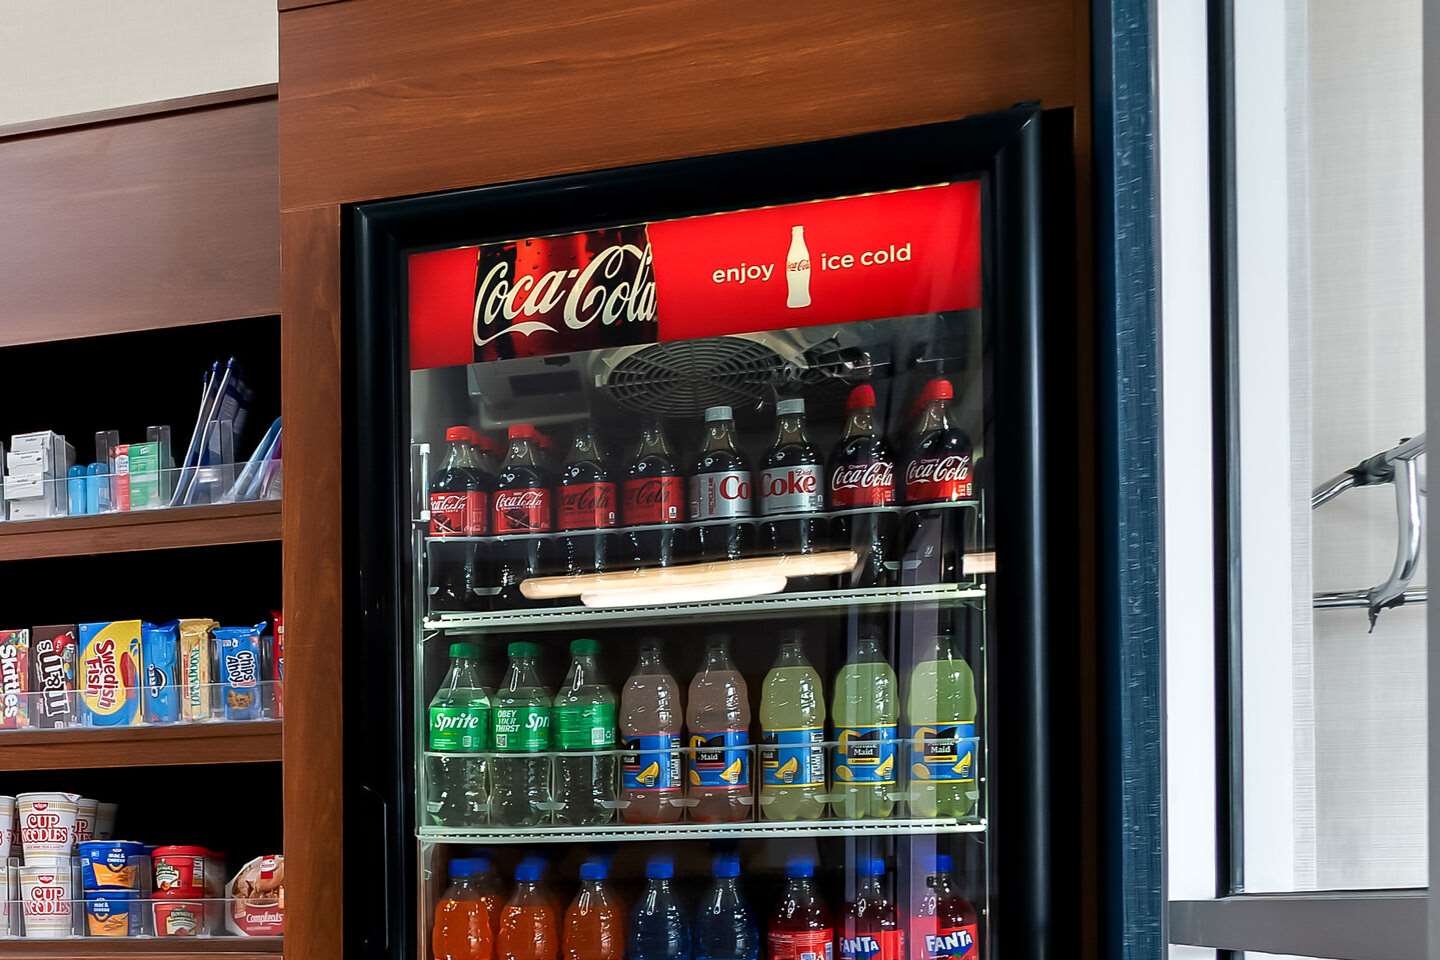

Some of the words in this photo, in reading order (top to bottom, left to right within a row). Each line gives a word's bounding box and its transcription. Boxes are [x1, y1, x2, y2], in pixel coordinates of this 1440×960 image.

[474, 244, 657, 346] Coca-Cola
[712, 262, 774, 285] enjoy
[821, 252, 854, 271] ice
[860, 243, 912, 267] cold
[832, 461, 893, 491] Coca-Cola
[906, 455, 969, 485] Coca-Cola
[760, 471, 817, 497] Coke
[85, 656, 102, 696] Fish
[95, 639, 118, 709] Swedish
[237, 651, 255, 681] Chips
[0, 644, 20, 718] Skittles
[435, 712, 479, 731] Sprite
[497, 710, 517, 718] OBEY
[495, 724, 520, 732] THIRST
[853, 748, 874, 756] Maid
[930, 746, 951, 754] Maid
[27, 813, 60, 829] CUP
[31, 887, 64, 901] CUP
[840, 936, 880, 953] FANTA
[925, 930, 973, 952] FANTA
